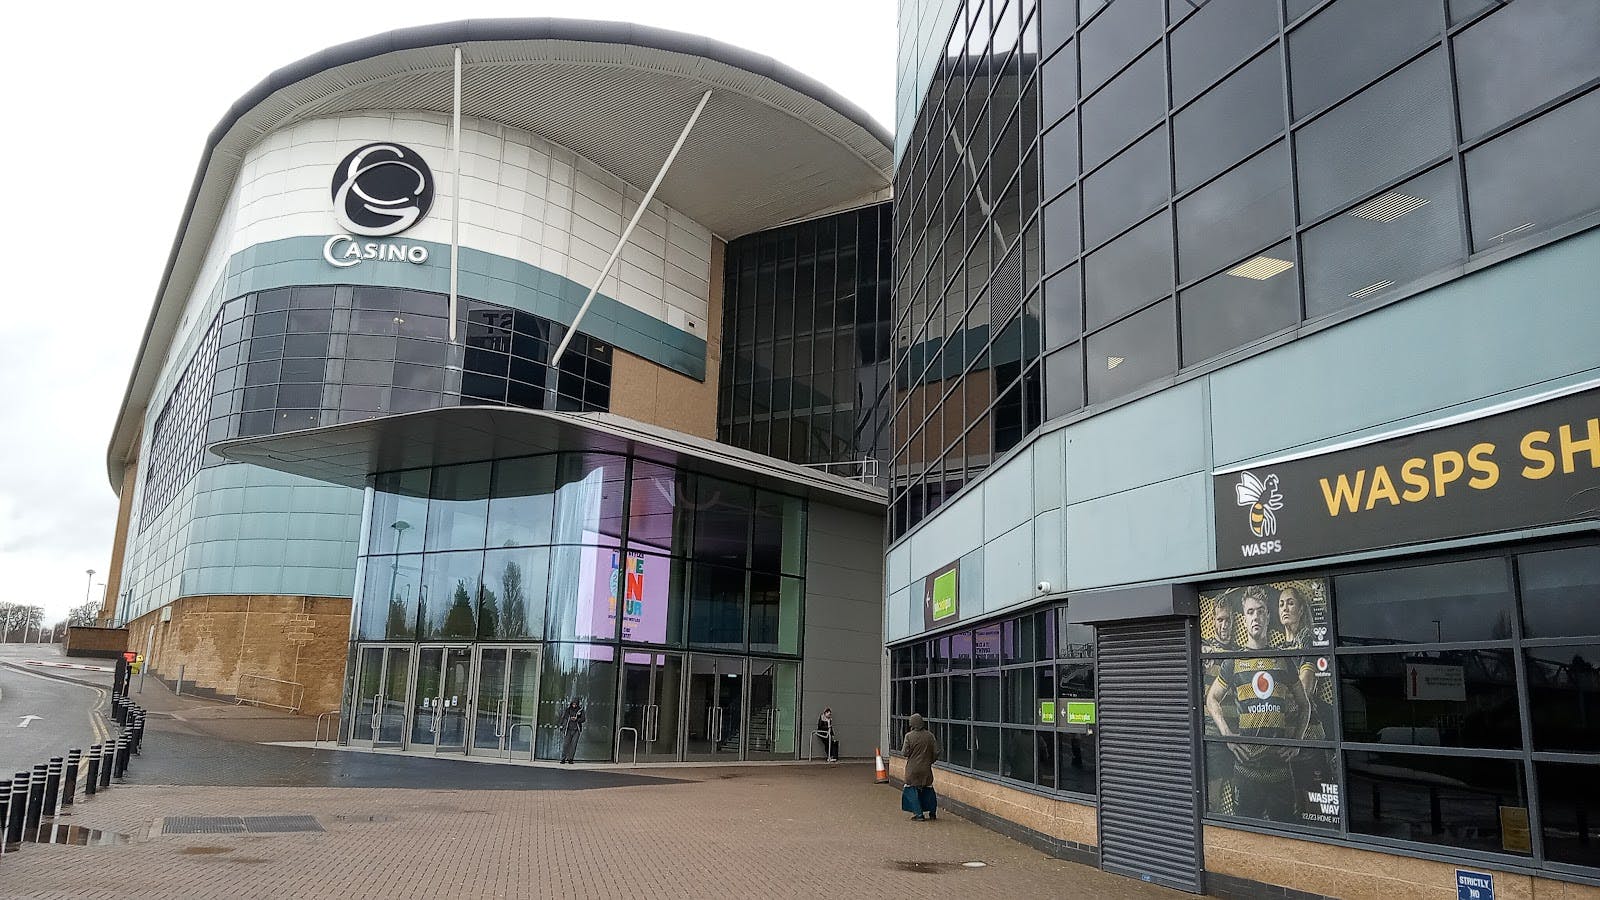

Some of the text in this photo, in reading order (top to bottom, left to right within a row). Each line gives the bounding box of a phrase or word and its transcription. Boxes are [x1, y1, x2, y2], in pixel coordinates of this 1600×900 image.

[1319, 417, 1600, 518] WASPS SH
[1241, 540, 1282, 557] WASPS
[611, 553, 645, 574] LVE
[607, 596, 642, 617] TUR
[1247, 702, 1281, 714] vodafone
[1321, 783, 1339, 794] THE
[1308, 791, 1340, 805] WASPS
[1320, 804, 1340, 816] WAY
[1458, 875, 1490, 888] STRICTLY
[1469, 889, 1480, 899] NO
